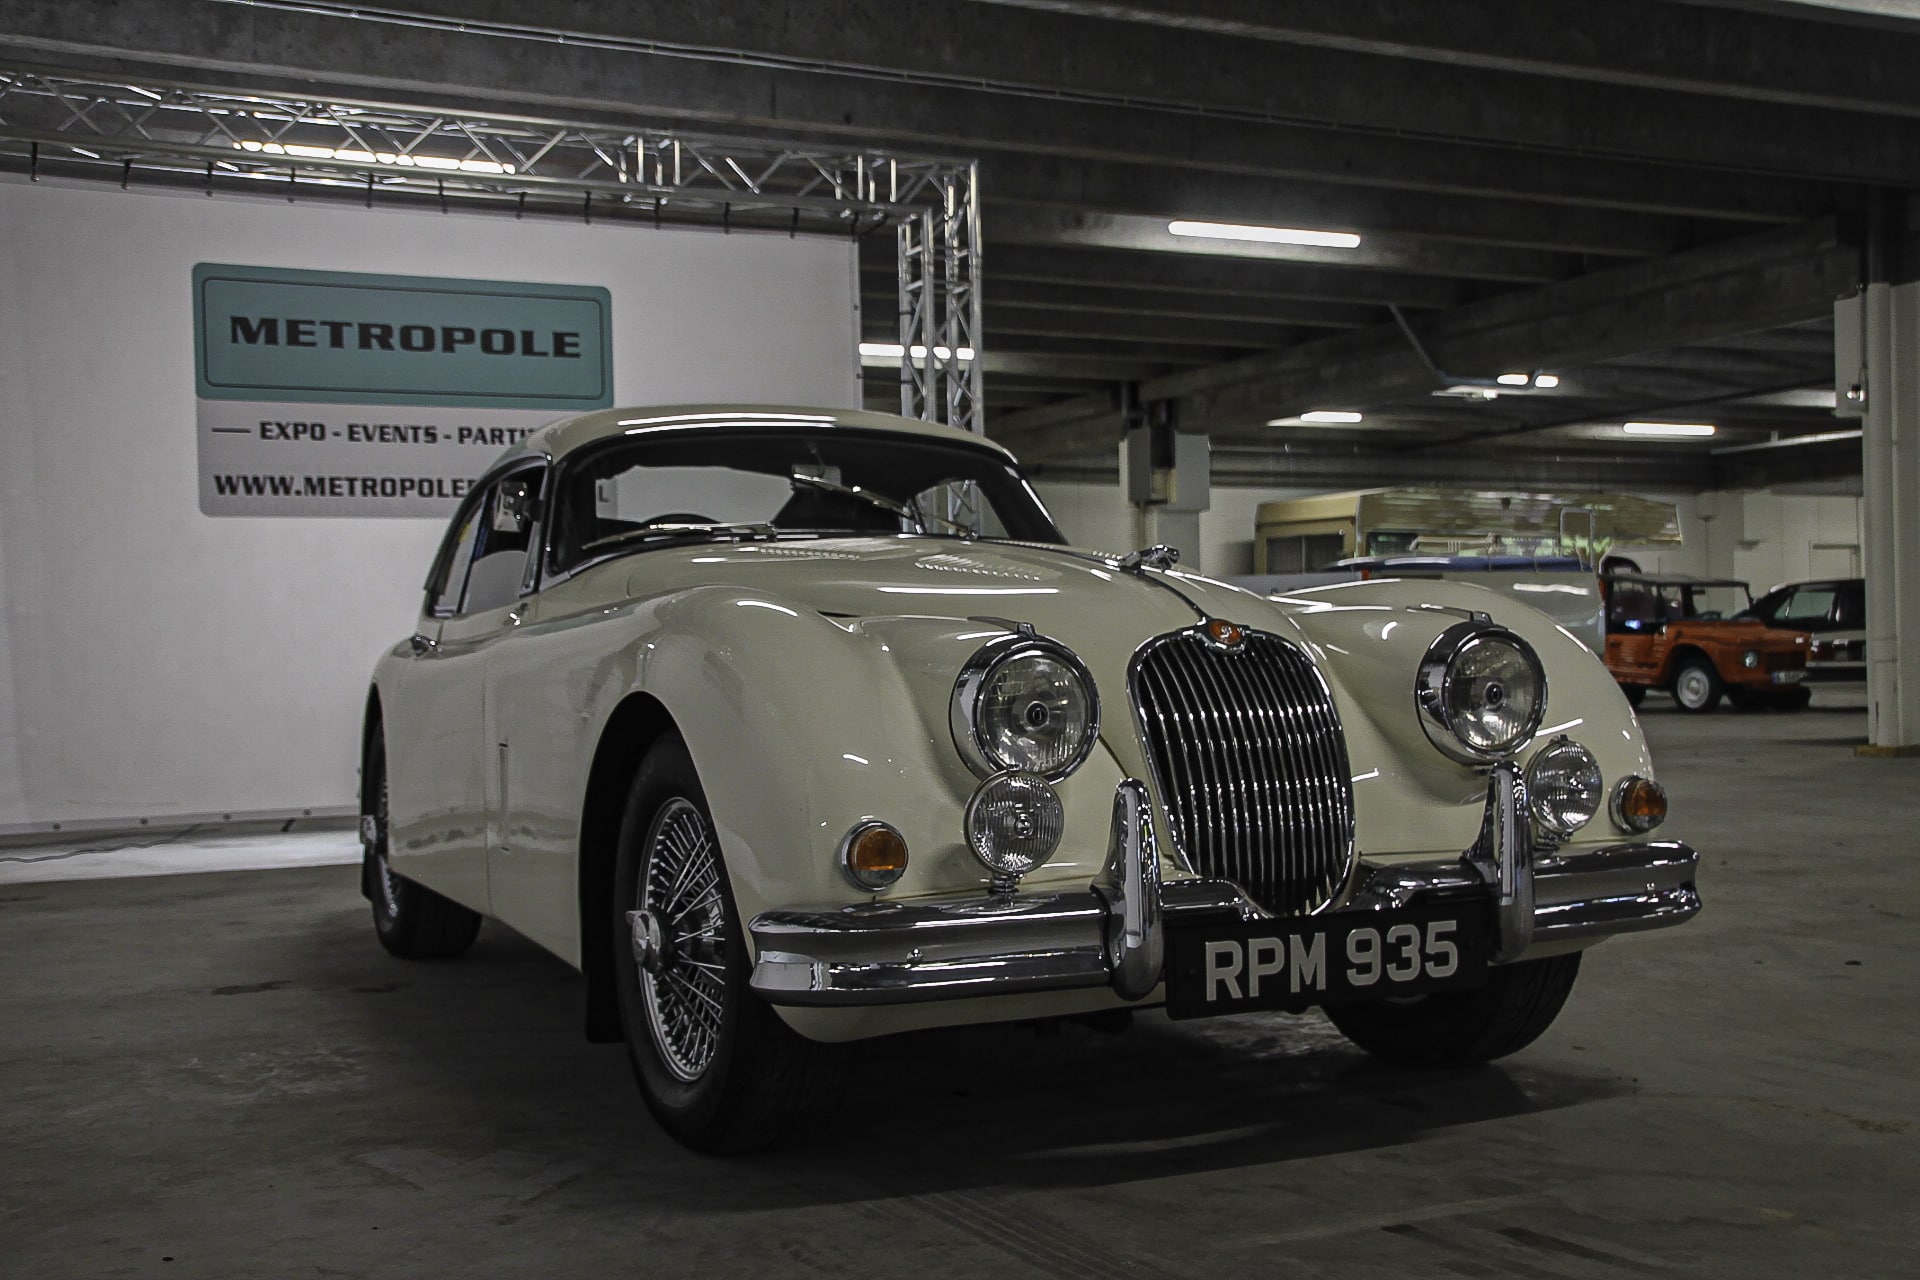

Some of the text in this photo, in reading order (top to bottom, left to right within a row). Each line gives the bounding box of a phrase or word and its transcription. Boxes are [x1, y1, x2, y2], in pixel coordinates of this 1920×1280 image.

[230, 315, 582, 359] METROPOLE
[259, 421, 326, 441] EXPO
[347, 423, 438, 444] EVENTS
[457, 426, 536, 446] PARTI
[1205, 919, 1458, 1001] RPM 935
